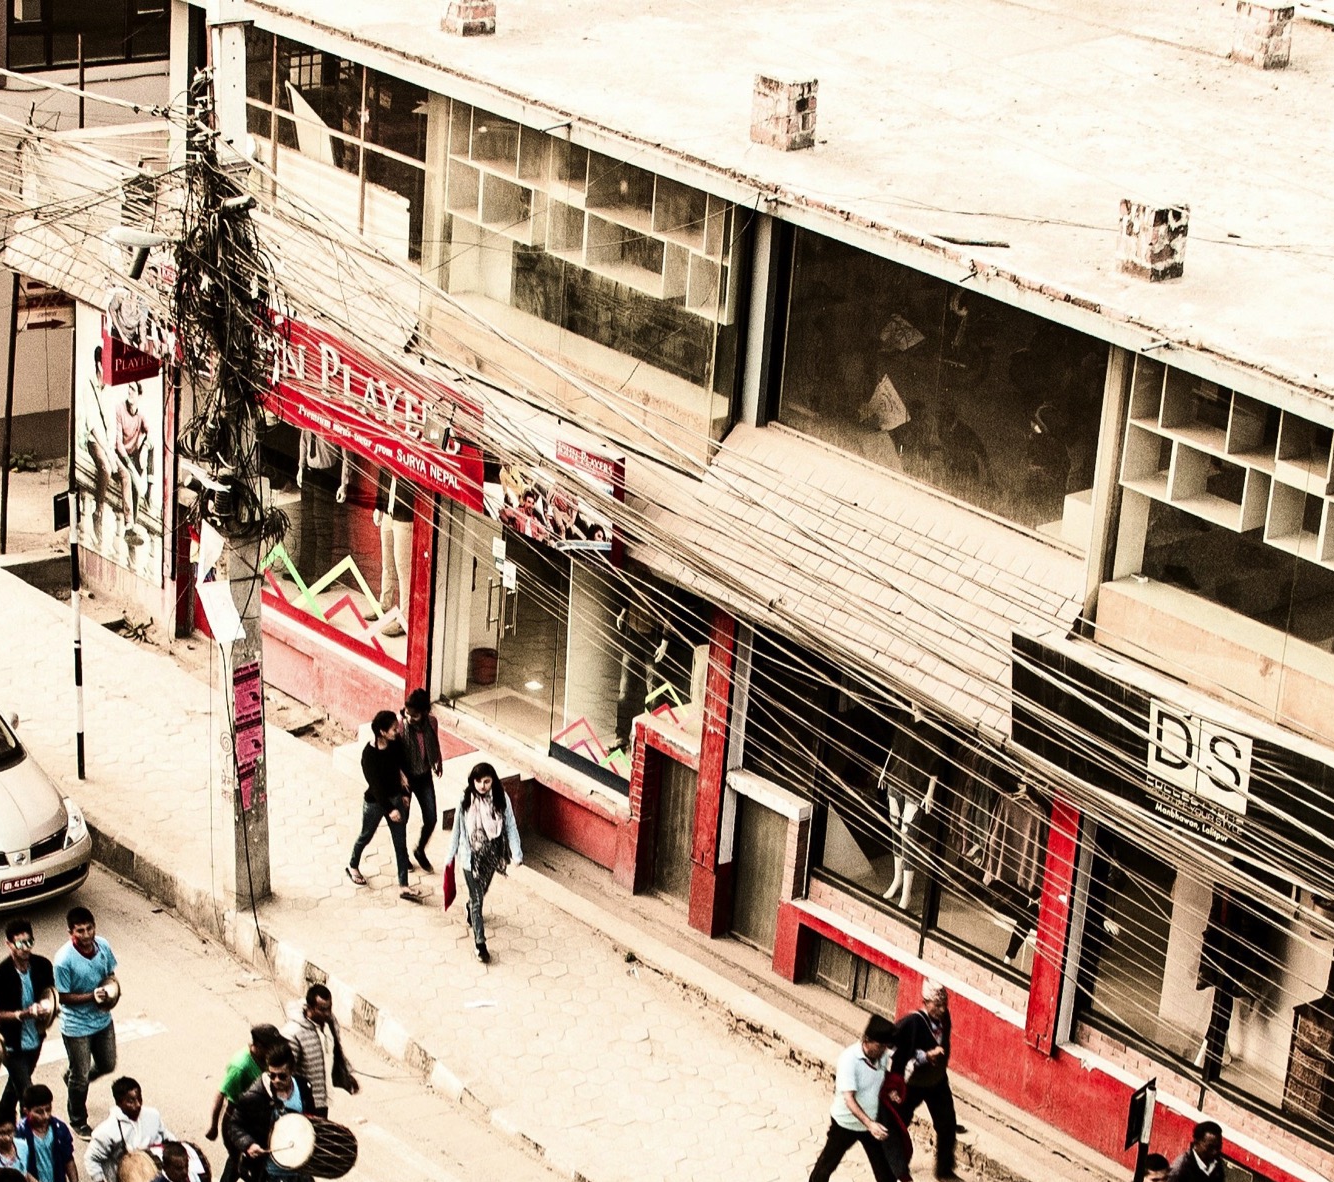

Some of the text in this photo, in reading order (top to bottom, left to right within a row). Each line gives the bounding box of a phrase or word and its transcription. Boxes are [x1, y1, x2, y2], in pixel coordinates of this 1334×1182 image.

[318, 341, 461, 456] PLAYE
[298, 403, 331, 429] Premium
[374, 443, 393, 458] from
[397, 448, 427, 475] SURYA
[430, 464, 461, 490] NEPAL
[1202, 823, 1228, 843] Lalitpur
